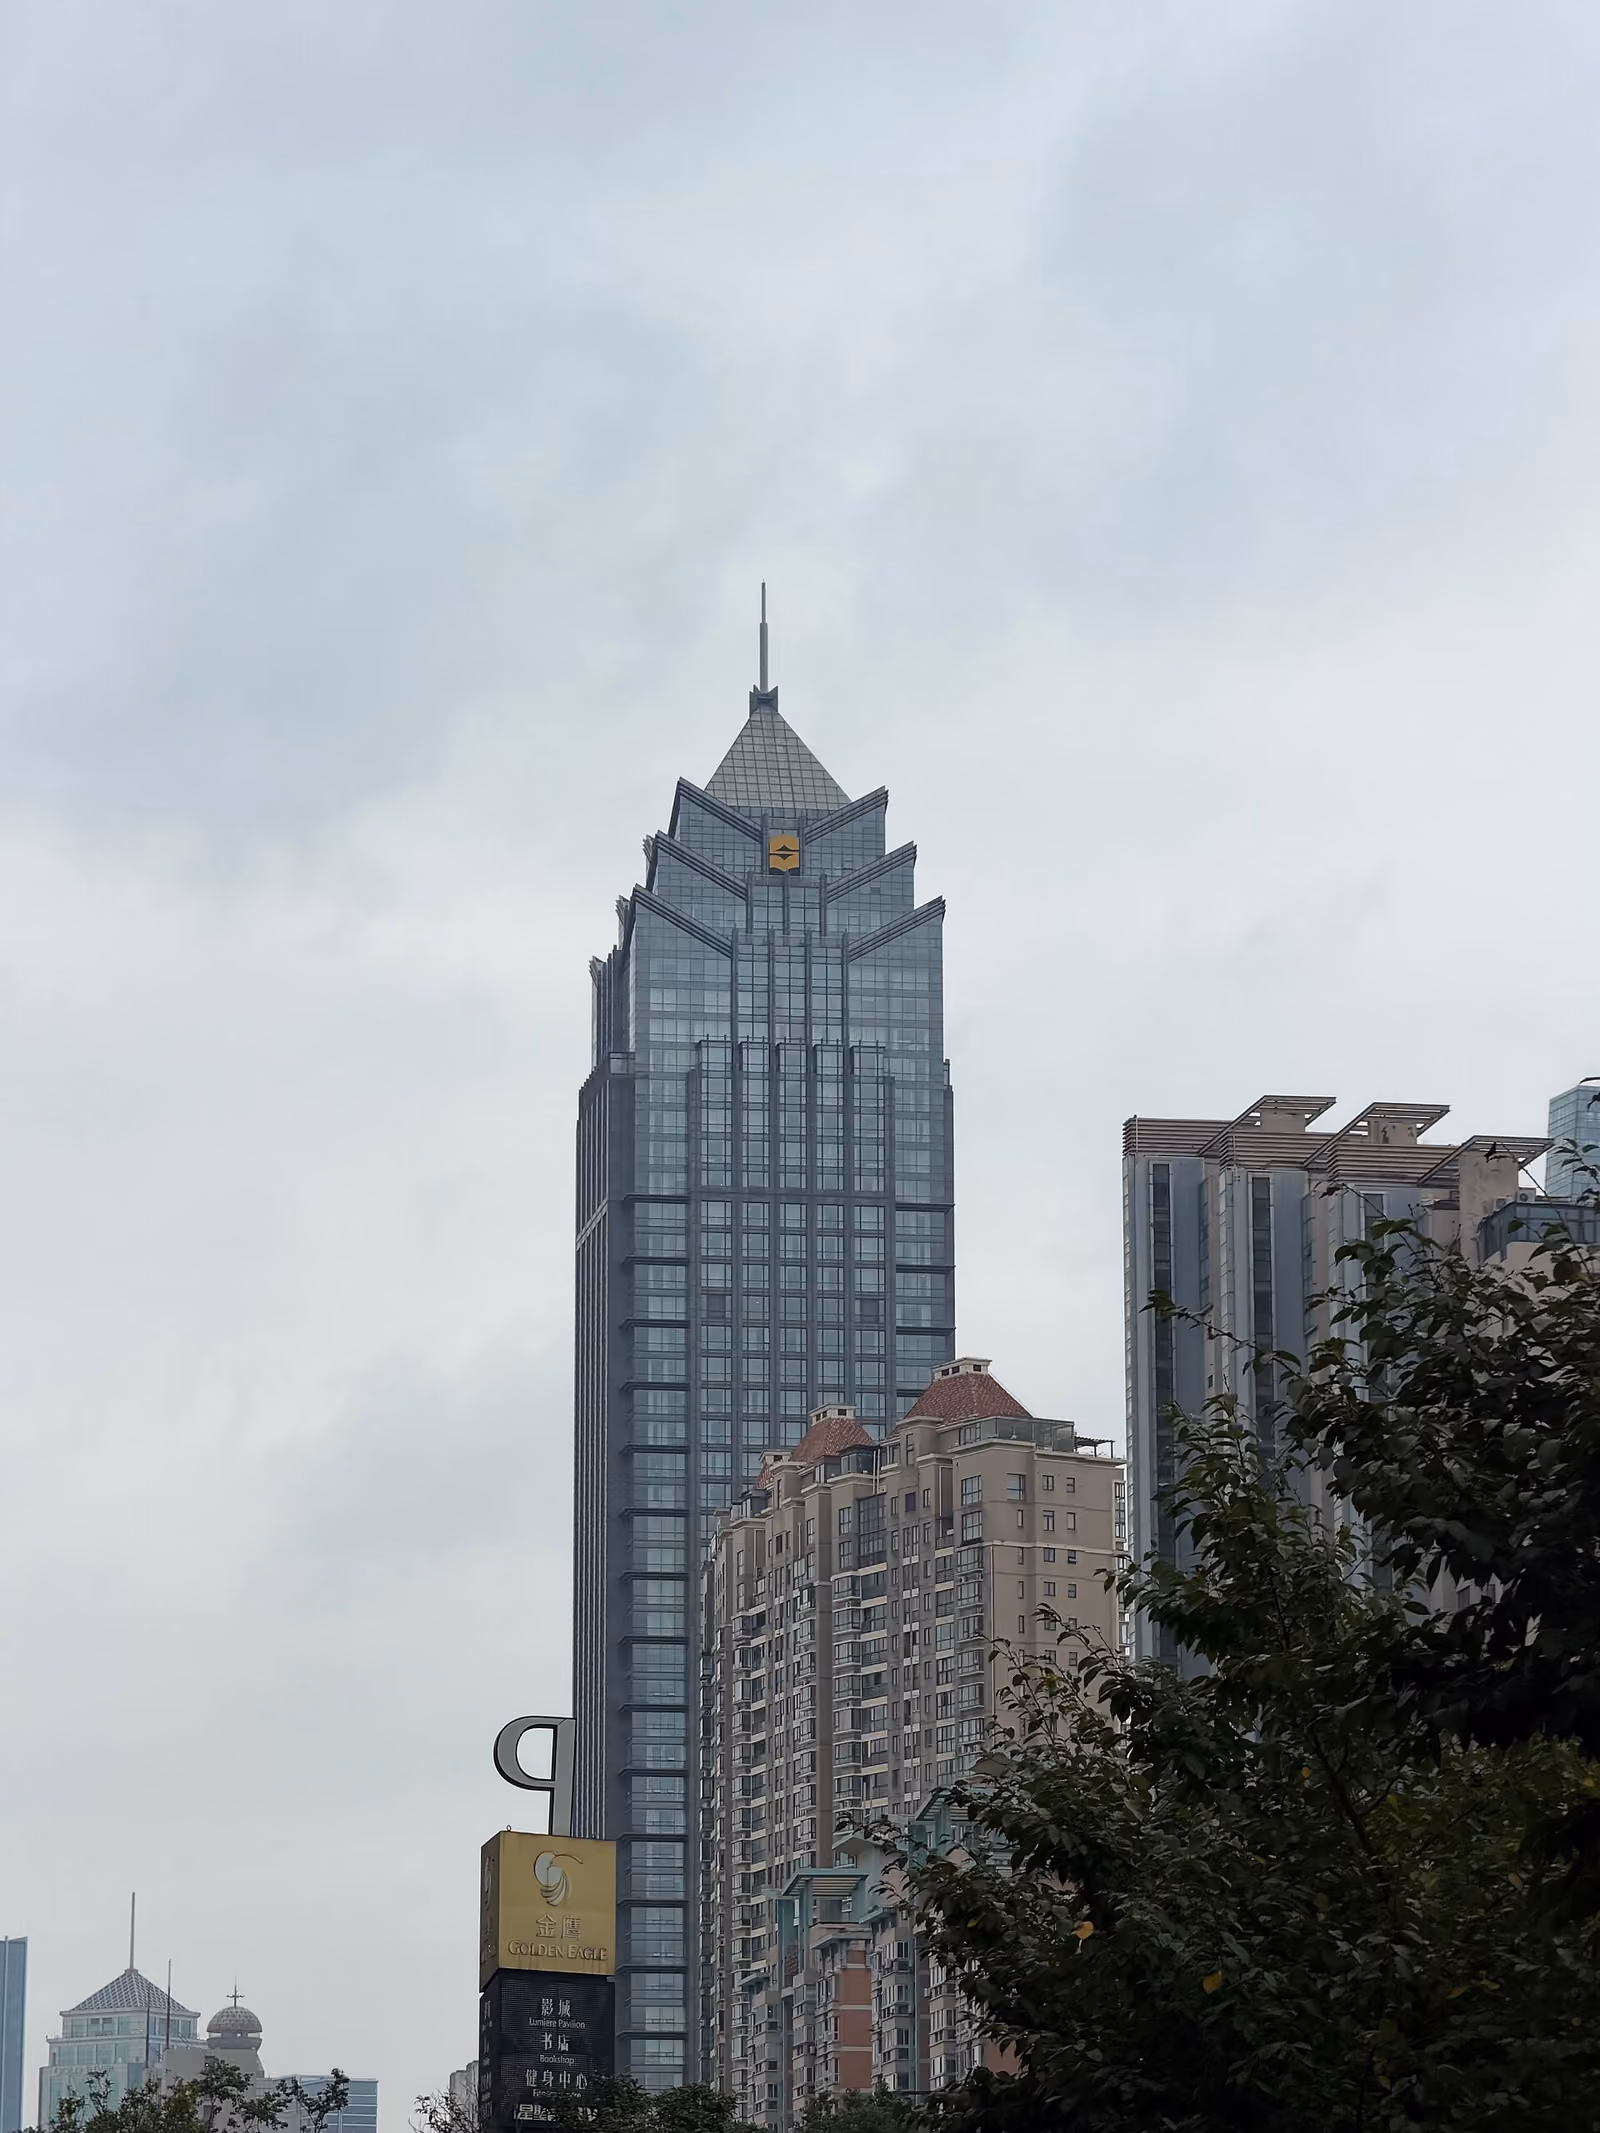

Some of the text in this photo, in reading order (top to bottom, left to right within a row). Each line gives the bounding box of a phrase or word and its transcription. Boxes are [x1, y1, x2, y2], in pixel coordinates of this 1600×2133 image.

[535, 1913, 582, 1940] 金鹰
[508, 1940, 565, 1959] GOLDEN
[567, 1945, 608, 1961] EAGLE
[541, 1998, 571, 2017] 影城
[529, 2017, 586, 2029] Lumiere Pavilion
[541, 2032, 570, 2051] 书店
[539, 2054, 575, 2066] Bookshop
[526, 2069, 588, 2089] 健身中心
